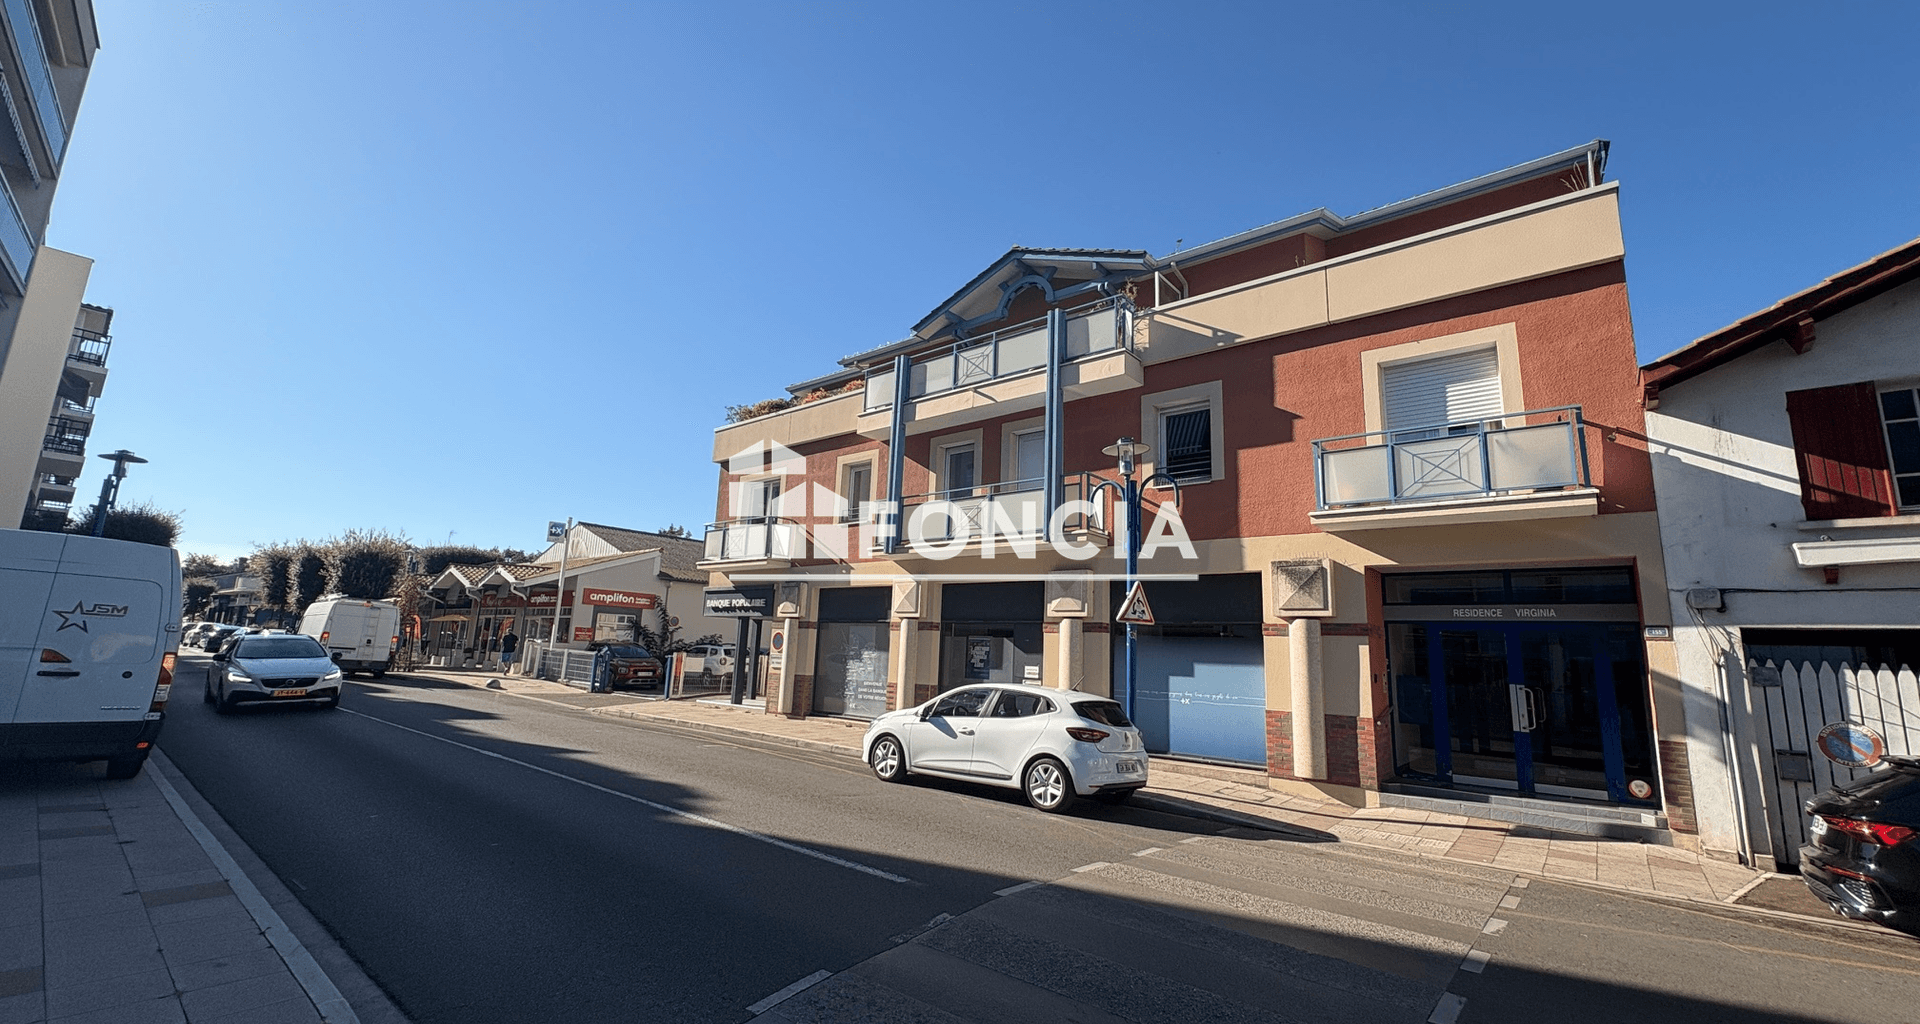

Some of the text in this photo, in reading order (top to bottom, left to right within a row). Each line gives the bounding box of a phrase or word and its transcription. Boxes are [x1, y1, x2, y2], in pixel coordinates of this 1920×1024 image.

[589, 591, 635, 604] amplifon
[706, 598, 766, 608] BANQUE POPULAIRE
[86, 604, 129, 615] JSM
[1453, 608, 1556, 618] RESIDENCE VIRGINIA
